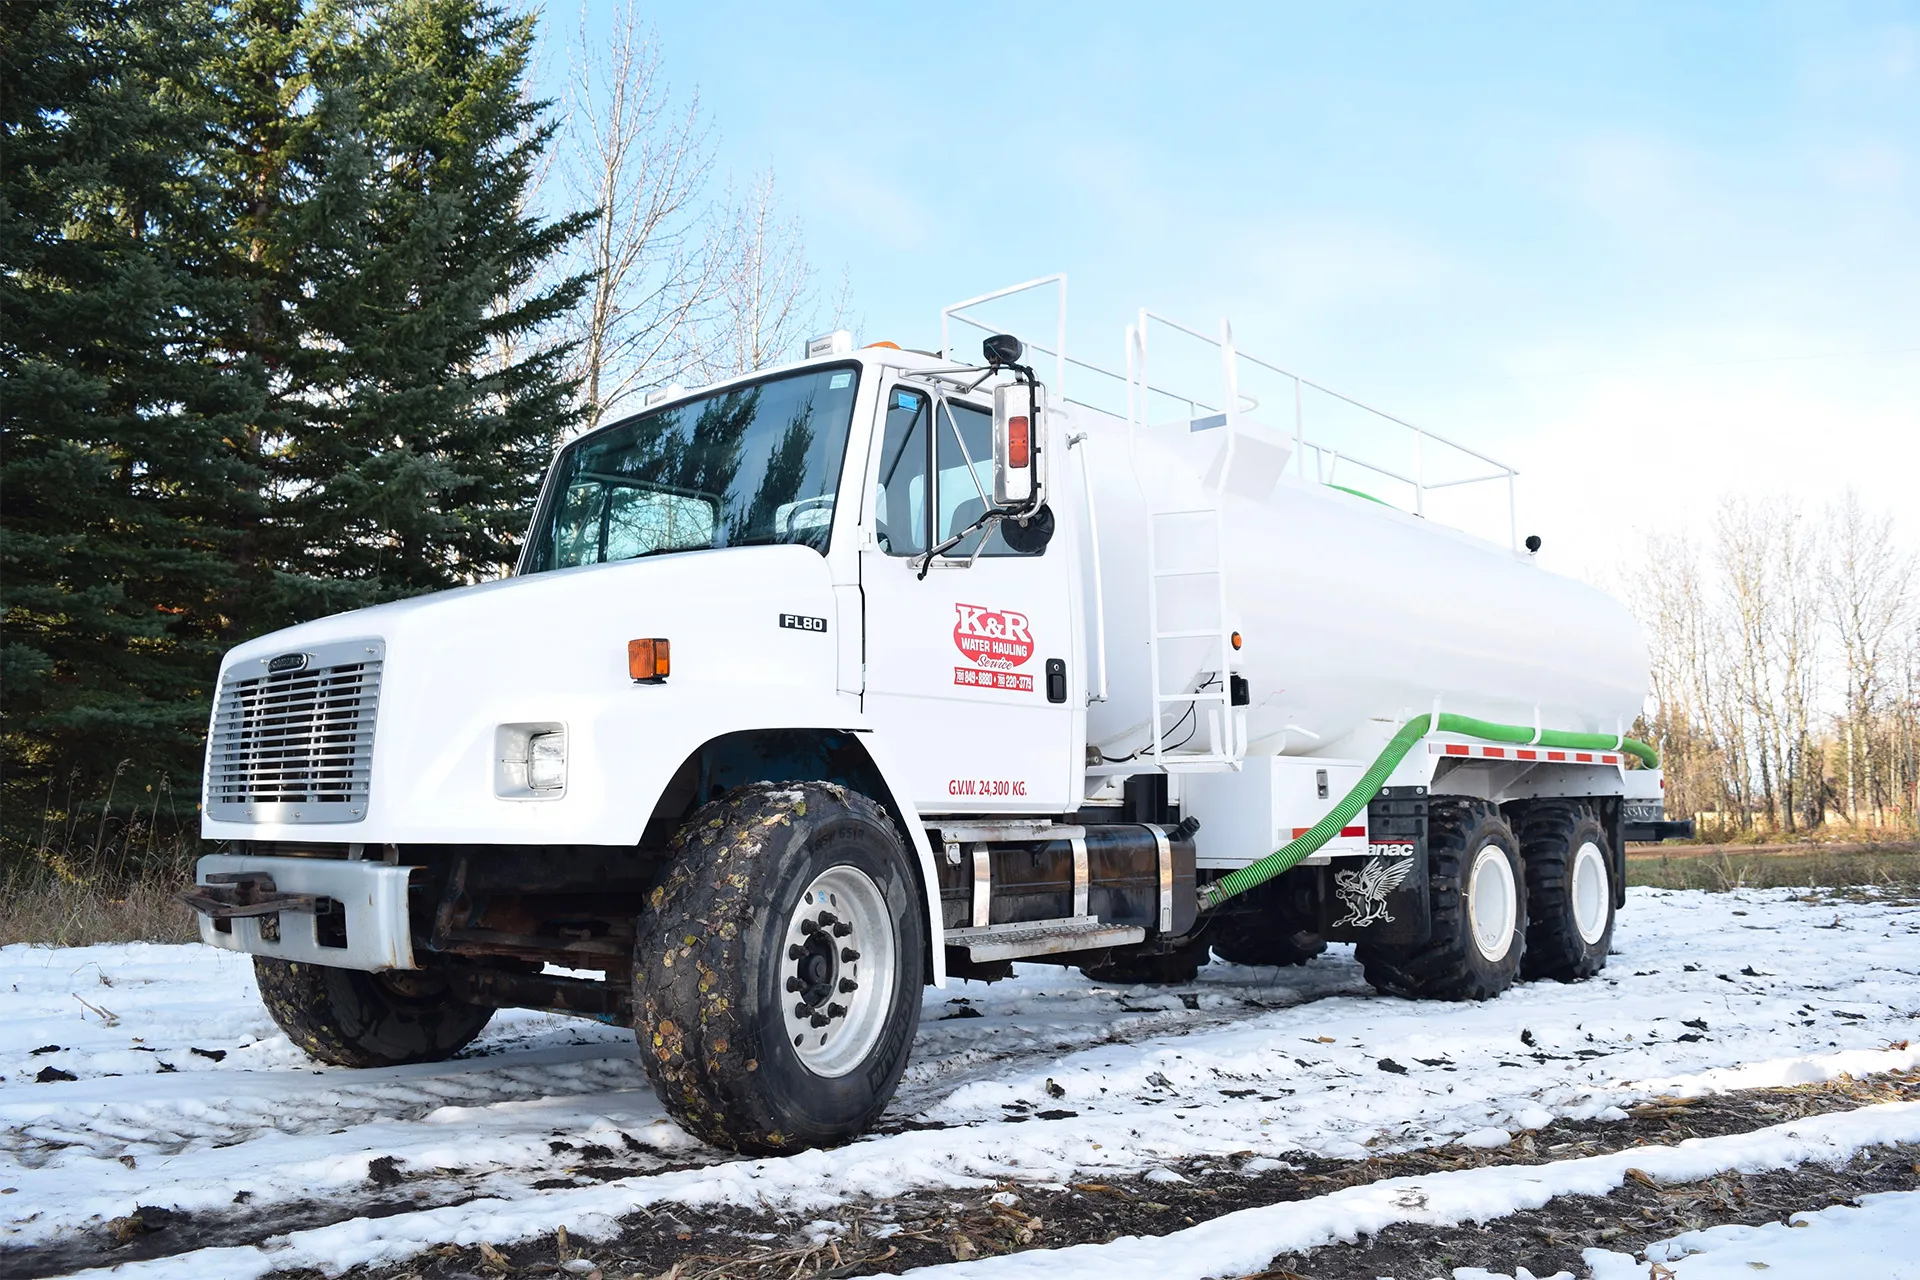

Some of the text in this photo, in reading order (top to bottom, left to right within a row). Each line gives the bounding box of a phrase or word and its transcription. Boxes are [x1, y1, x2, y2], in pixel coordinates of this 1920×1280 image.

[785, 615, 823, 631] FL80
[955, 603, 1032, 643] K&R
[961, 637, 1028, 657] WATER HAULING
[978, 655, 1013, 670] Service
[948, 779, 1027, 797] G.V.W. 24,300 KG.
[1369, 843, 1414, 857] anac
